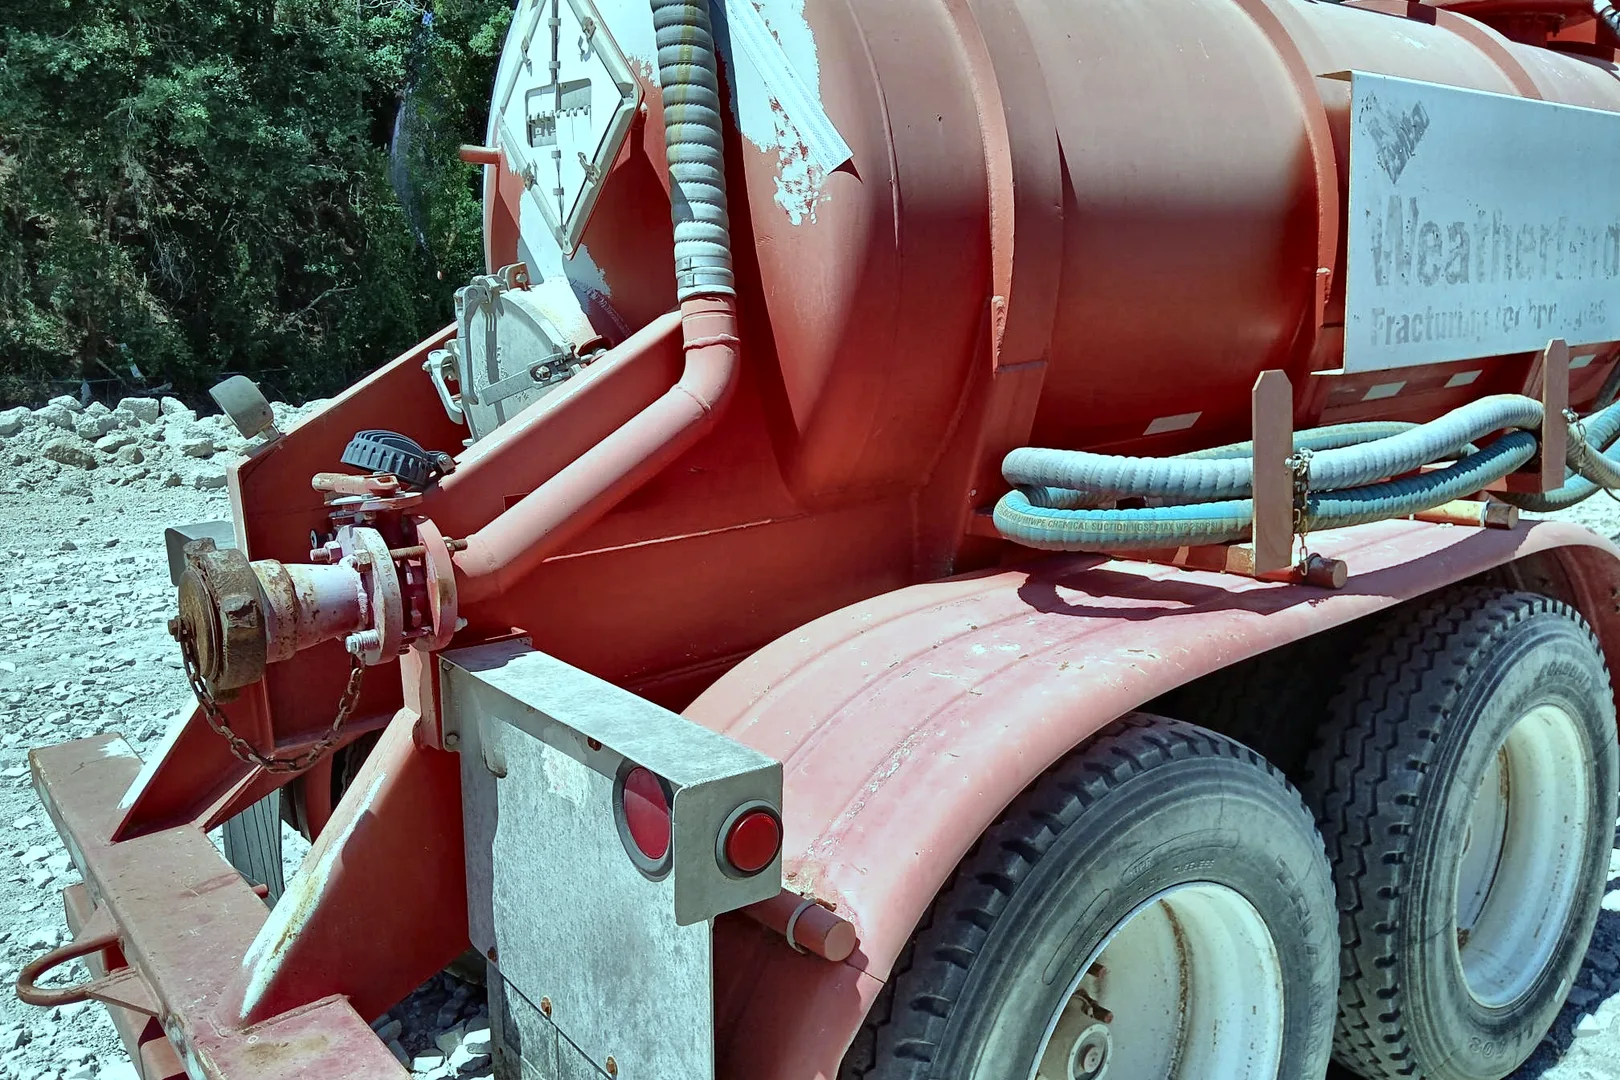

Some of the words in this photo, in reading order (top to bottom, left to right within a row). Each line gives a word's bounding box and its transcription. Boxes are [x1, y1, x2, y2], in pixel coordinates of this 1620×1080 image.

[1048, 520, 1088, 531] CHEMICAL
[1091, 522, 1128, 531] SUCTION
[1131, 523, 1153, 531] HOSE
[1156, 522, 1174, 531] MAX
